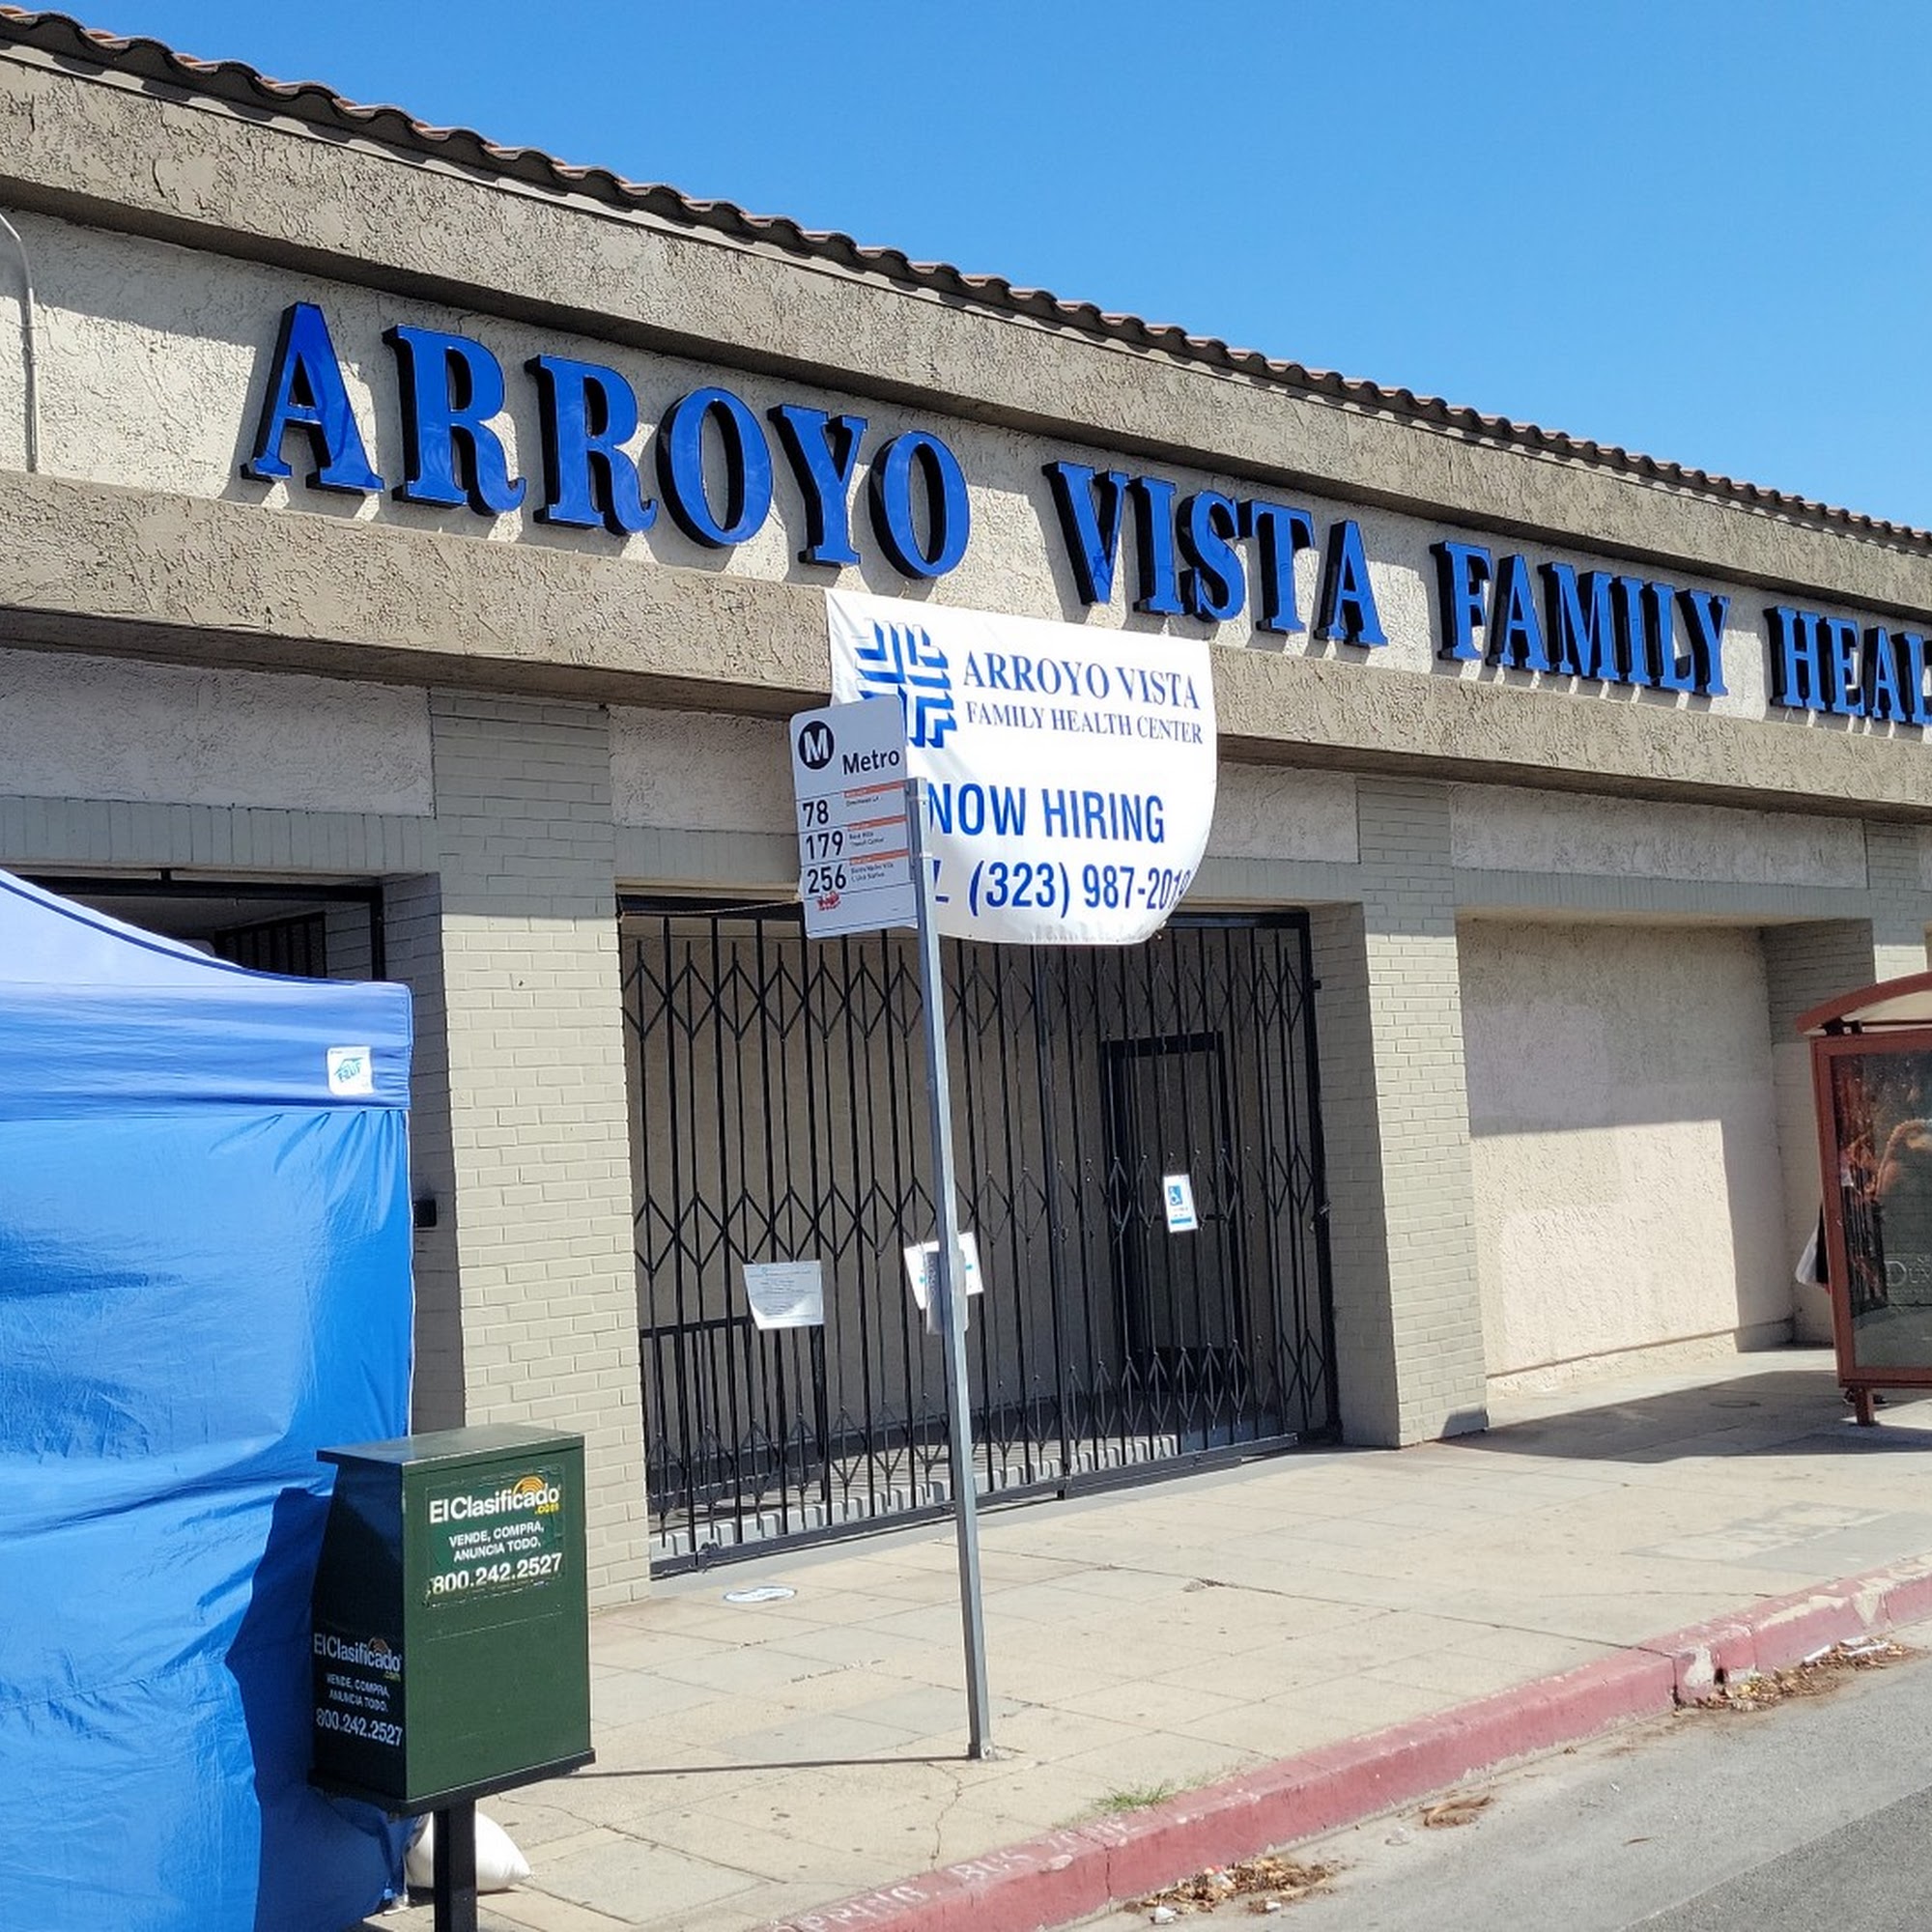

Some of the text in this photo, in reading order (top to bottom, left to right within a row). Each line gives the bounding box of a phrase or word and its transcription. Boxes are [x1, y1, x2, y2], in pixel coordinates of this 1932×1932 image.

[242, 300, 1932, 726] ARROYO VISTA FAMILY HEAL
[964, 651, 1201, 710] ARROYO VISTA
[966, 701, 1204, 745] FAMILY HEALTH CENTER
[842, 750, 899, 775] Metro
[803, 800, 829, 827] 78
[927, 783, 1164, 843] NOW HIRING
[806, 831, 843, 860] 179
[808, 865, 846, 894] 256
[969, 860, 1070, 918] (323)
[449, 1520, 544, 1548] VENDE, COMPRA,
[454, 1543, 504, 1562] ANUNCIA
[433, 1552, 562, 1595] 800.242.2527
[316, 1708, 403, 1747] 800.242.2527
